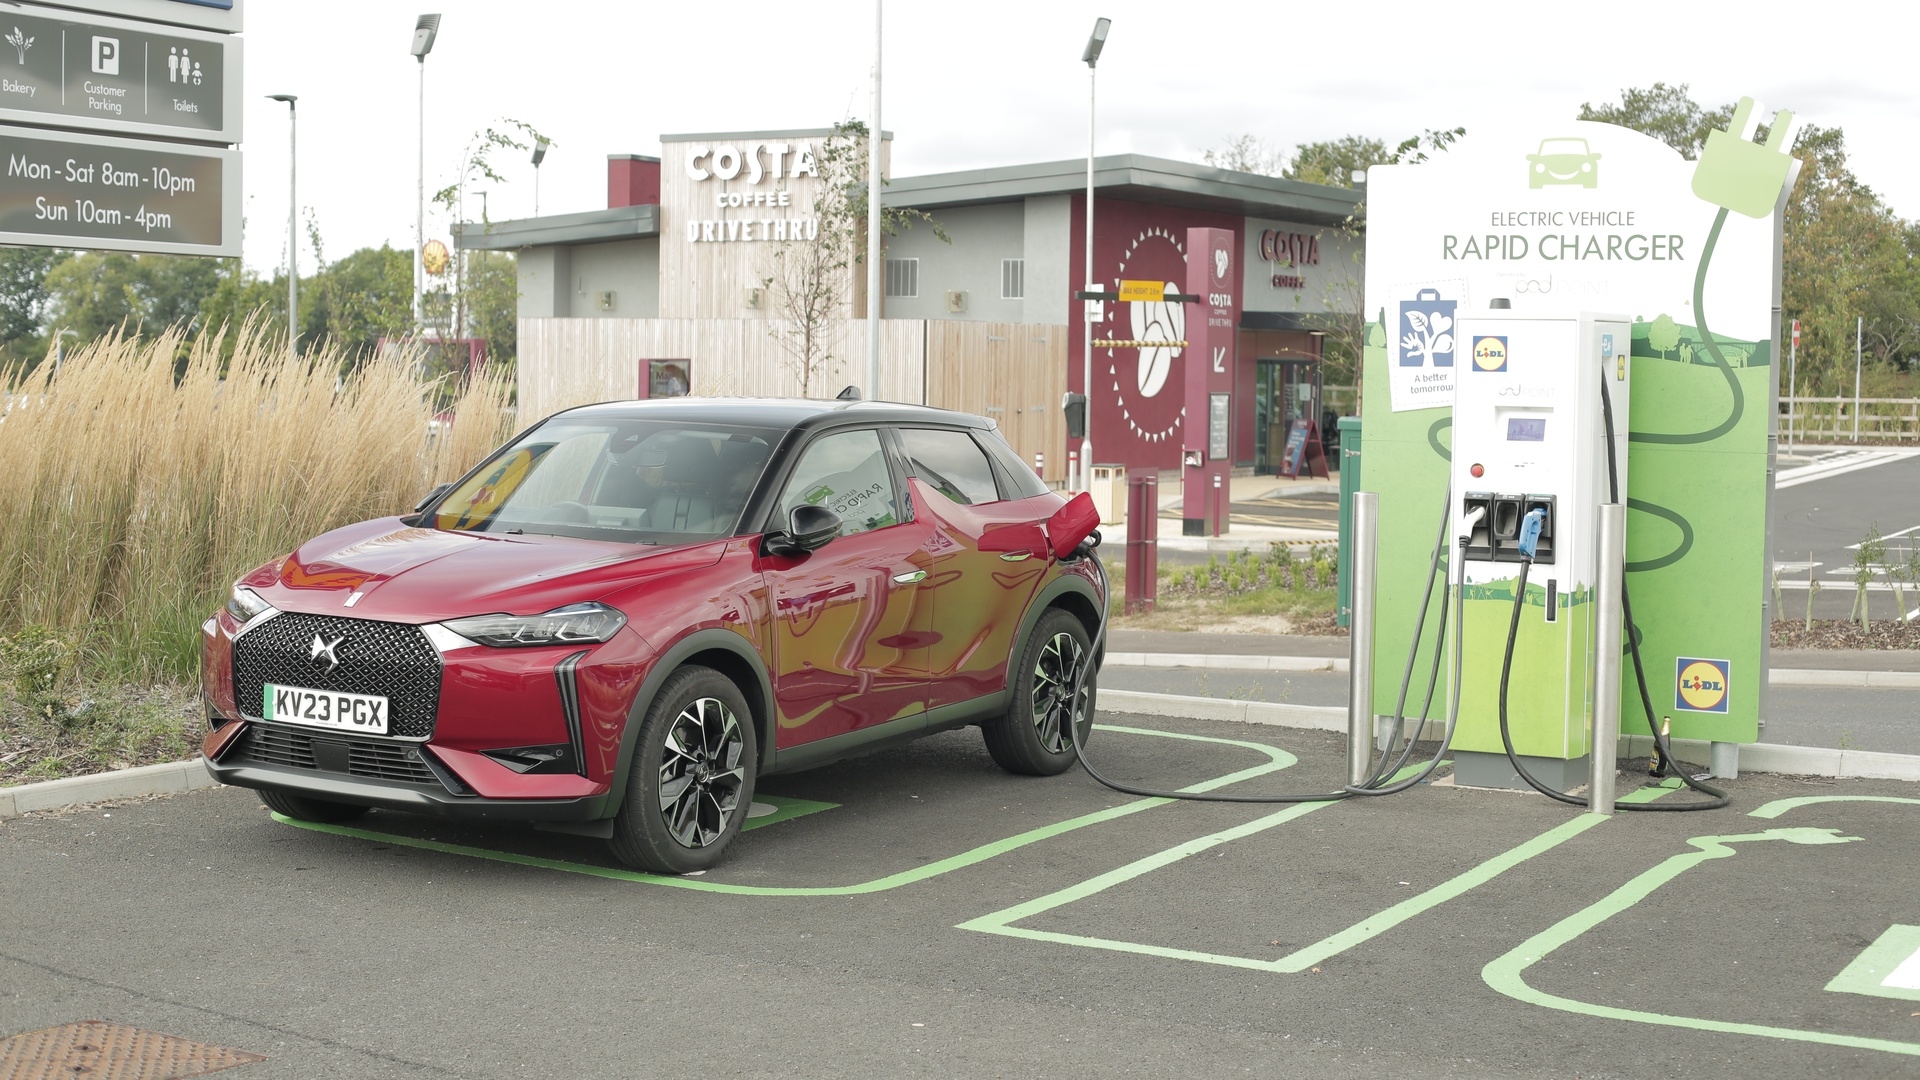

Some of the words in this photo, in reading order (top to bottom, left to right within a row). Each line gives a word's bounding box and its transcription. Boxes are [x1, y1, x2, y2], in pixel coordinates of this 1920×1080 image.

[2, 79, 36, 97] Bakery
[84, 81, 126, 97] Customer
[88, 97, 122, 115] Parking
[172, 99, 198, 113] Toilets
[684, 142, 819, 185] COSTA
[716, 190, 790, 208] COFFEE
[35, 196, 68, 221] Sun
[1491, 211, 1563, 226] ELECTRIC
[1568, 211, 1635, 226] VEHICLE
[687, 218, 753, 243] DRIVE
[760, 217, 818, 241] THRU
[1259, 229, 1320, 268] COSTA
[1443, 235, 1529, 260] RAPID
[1538, 234, 1685, 261] CHARGER
[1209, 293, 1232, 307] COSTA
[1209, 318, 1221, 327] DRIVE
[1222, 319, 1232, 327] THRU
[1414, 375, 1421, 383] A
[1423, 373, 1448, 383] better
[1410, 384, 1454, 394] tomorrow
[276, 689, 330, 721] KV23
[337, 697, 382, 728] PGX
